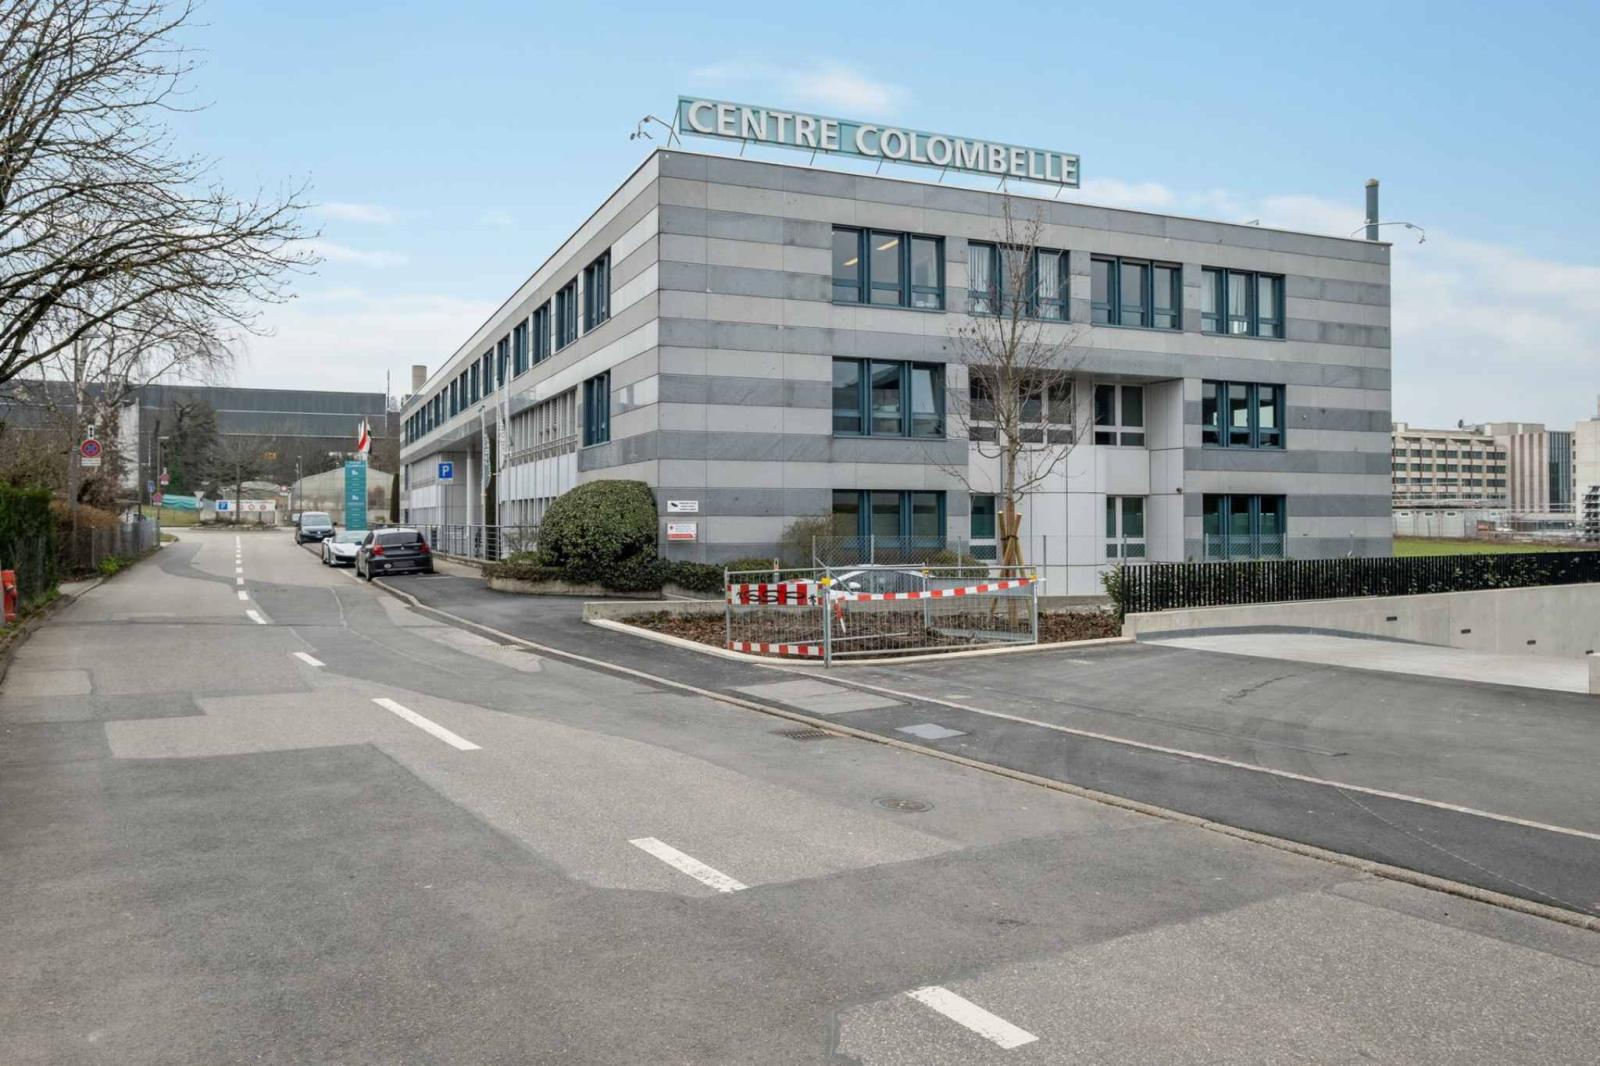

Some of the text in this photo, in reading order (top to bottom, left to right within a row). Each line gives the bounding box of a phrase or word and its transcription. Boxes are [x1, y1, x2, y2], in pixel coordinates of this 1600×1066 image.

[688, 100, 1077, 182] CENTRE COLOMBELLE
[442, 465, 450, 477] P
